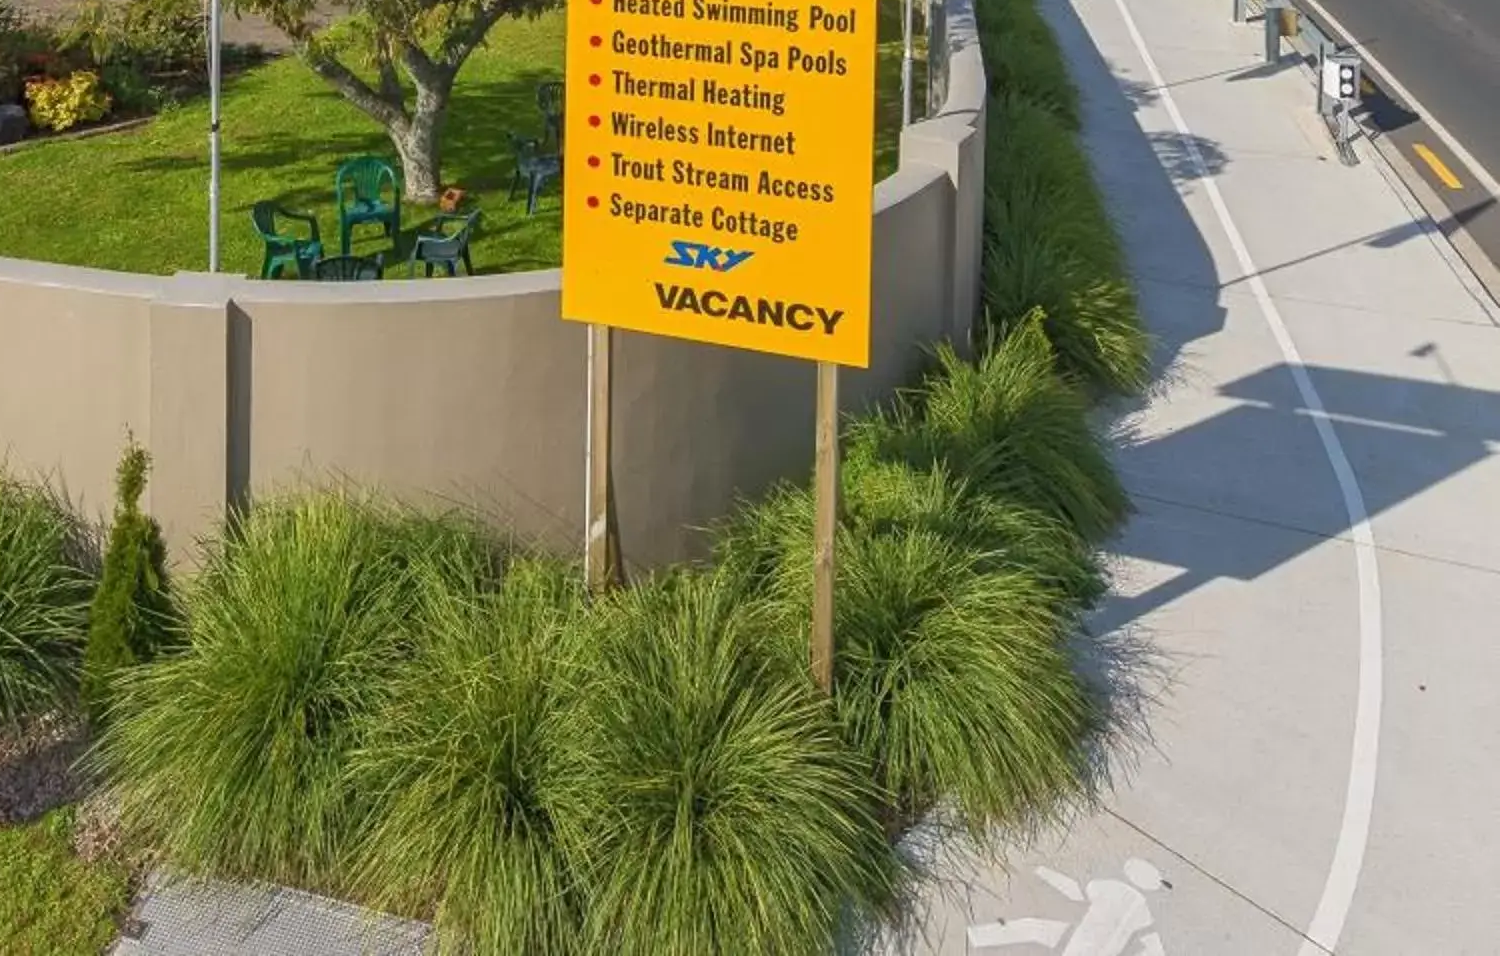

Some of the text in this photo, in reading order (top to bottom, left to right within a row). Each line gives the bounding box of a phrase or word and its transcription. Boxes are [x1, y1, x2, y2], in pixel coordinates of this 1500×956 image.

[809, 6, 856, 34] Pool
[612, 31, 848, 76] Geothermal Spa Pools
[612, 71, 786, 116] Thermal Heating
[611, 113, 796, 155] Wireless Internet
[611, 153, 835, 203] Trout Stream Access
[610, 194, 798, 242] Separate Cottage
[664, 240, 755, 272] SKY
[654, 283, 844, 335] VACANCY
